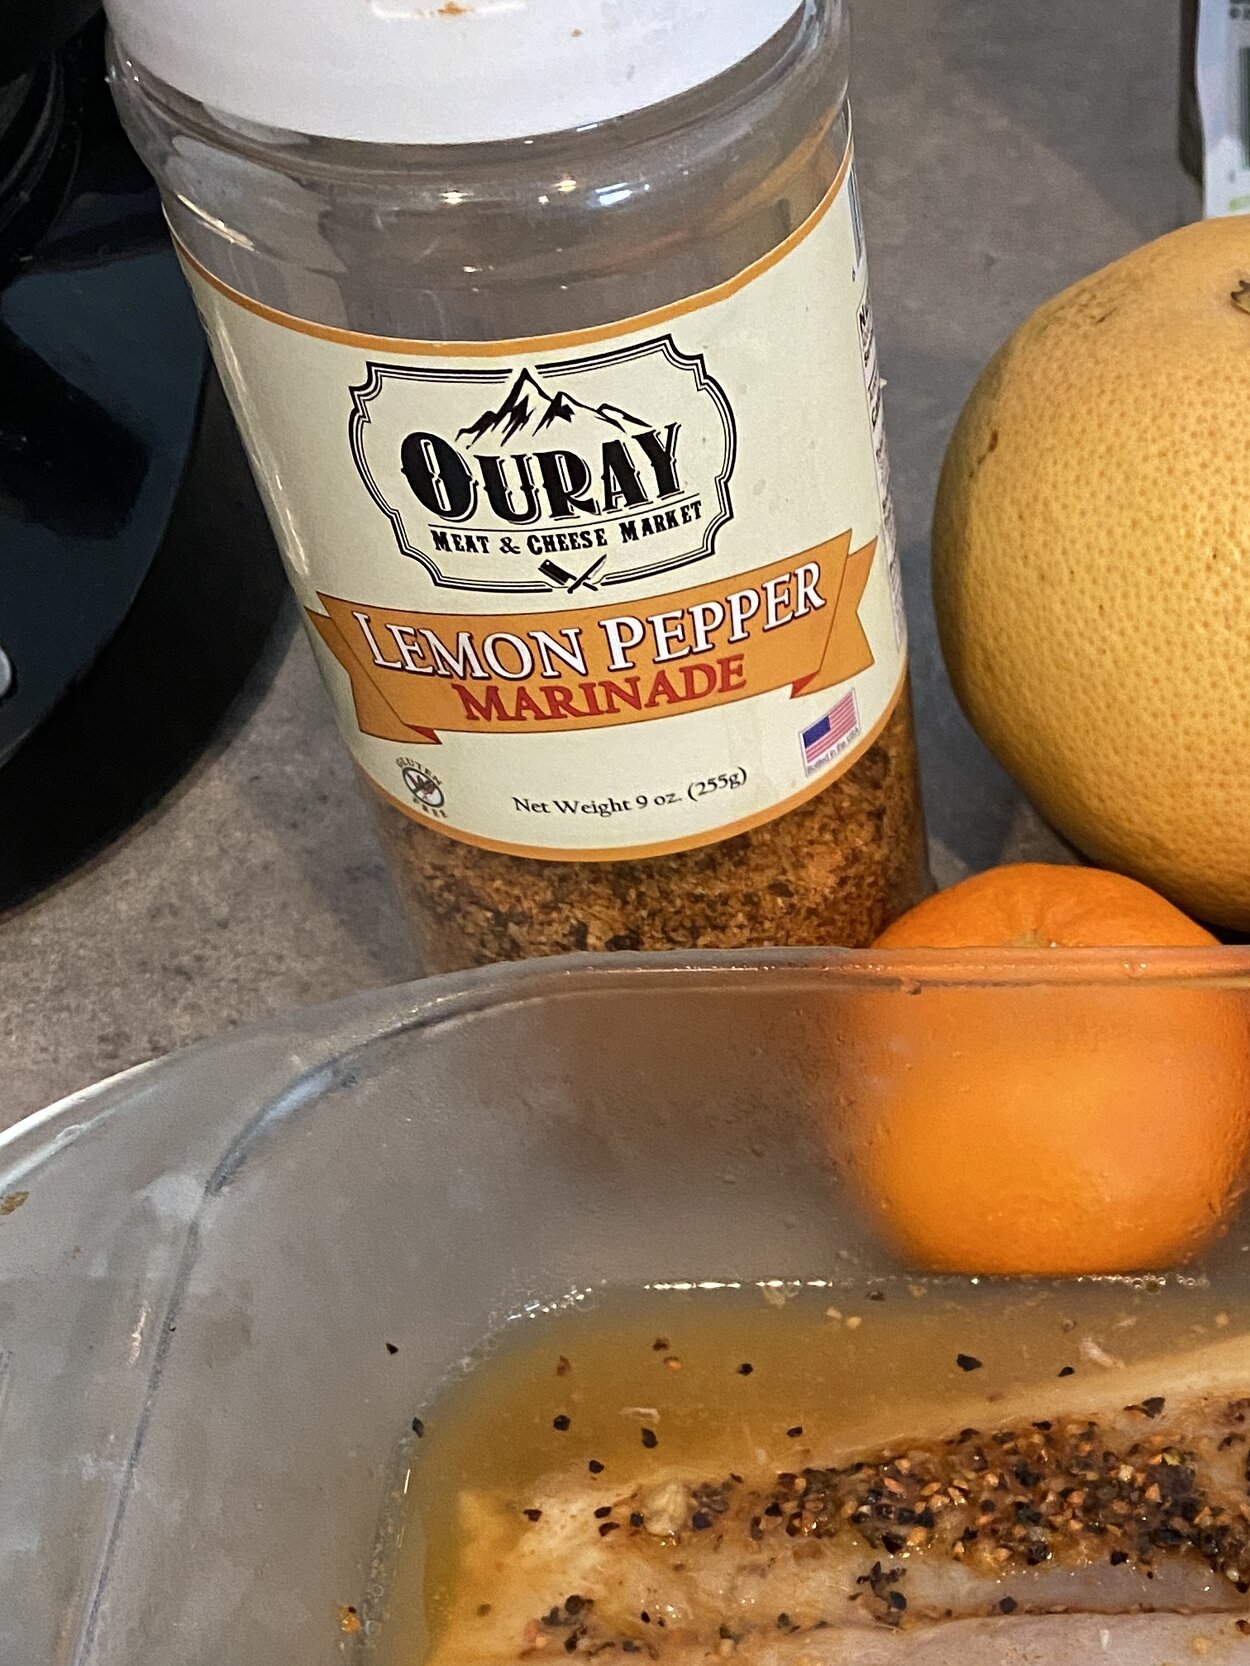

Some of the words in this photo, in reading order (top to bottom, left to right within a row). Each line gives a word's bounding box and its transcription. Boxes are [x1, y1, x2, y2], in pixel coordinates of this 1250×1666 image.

[400, 422, 685, 524] OURAY
[430, 529, 490, 554] MEAT
[499, 536, 521, 556] &
[526, 528, 608, 556] CHEESE
[619, 500, 703, 543] MARKET
[352, 610, 589, 681] LEMON
[600, 560, 827, 672] PEPPER
[452, 653, 748, 722] MARINADE
[512, 797, 551, 814] Net
[553, 797, 632, 818] Weight
[635, 795, 648, 810] 9
[687, 766, 748, 802] (255g)
